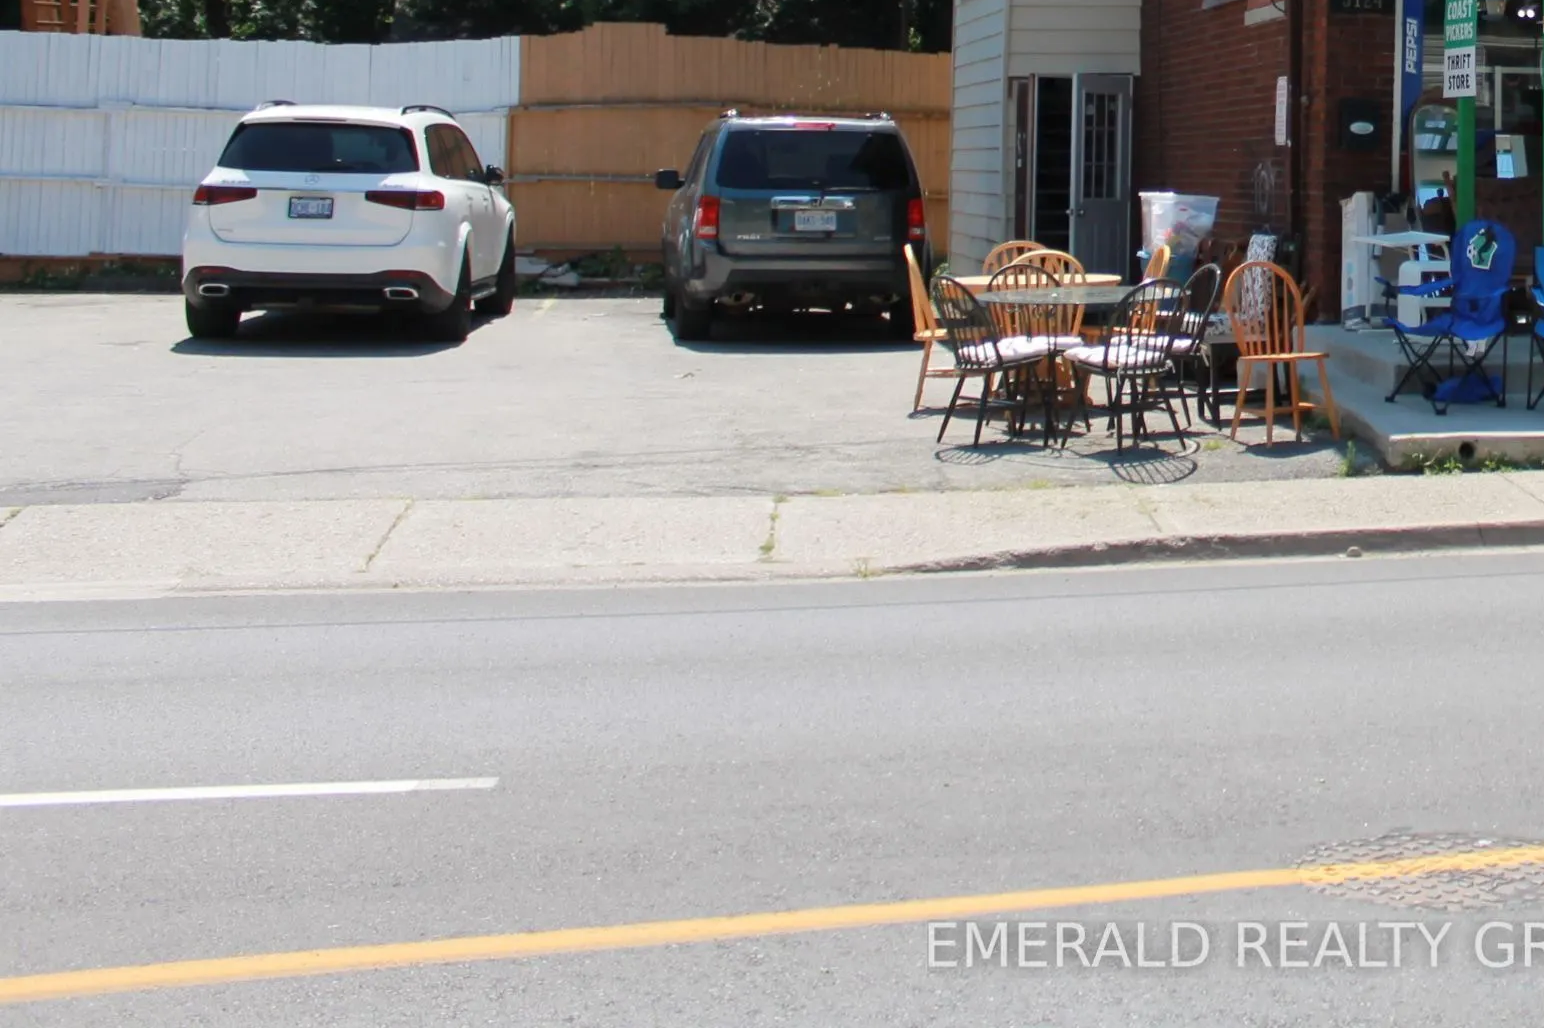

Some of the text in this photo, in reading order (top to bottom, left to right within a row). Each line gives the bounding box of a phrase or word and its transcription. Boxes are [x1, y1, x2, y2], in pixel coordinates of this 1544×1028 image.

[1447, 0, 1473, 20] COAST
[1446, 22, 1473, 42] PICKERS
[1405, 17, 1418, 74] PEPSI
[1447, 53, 1471, 71] THRIFT
[1448, 73, 1470, 91] STORE
